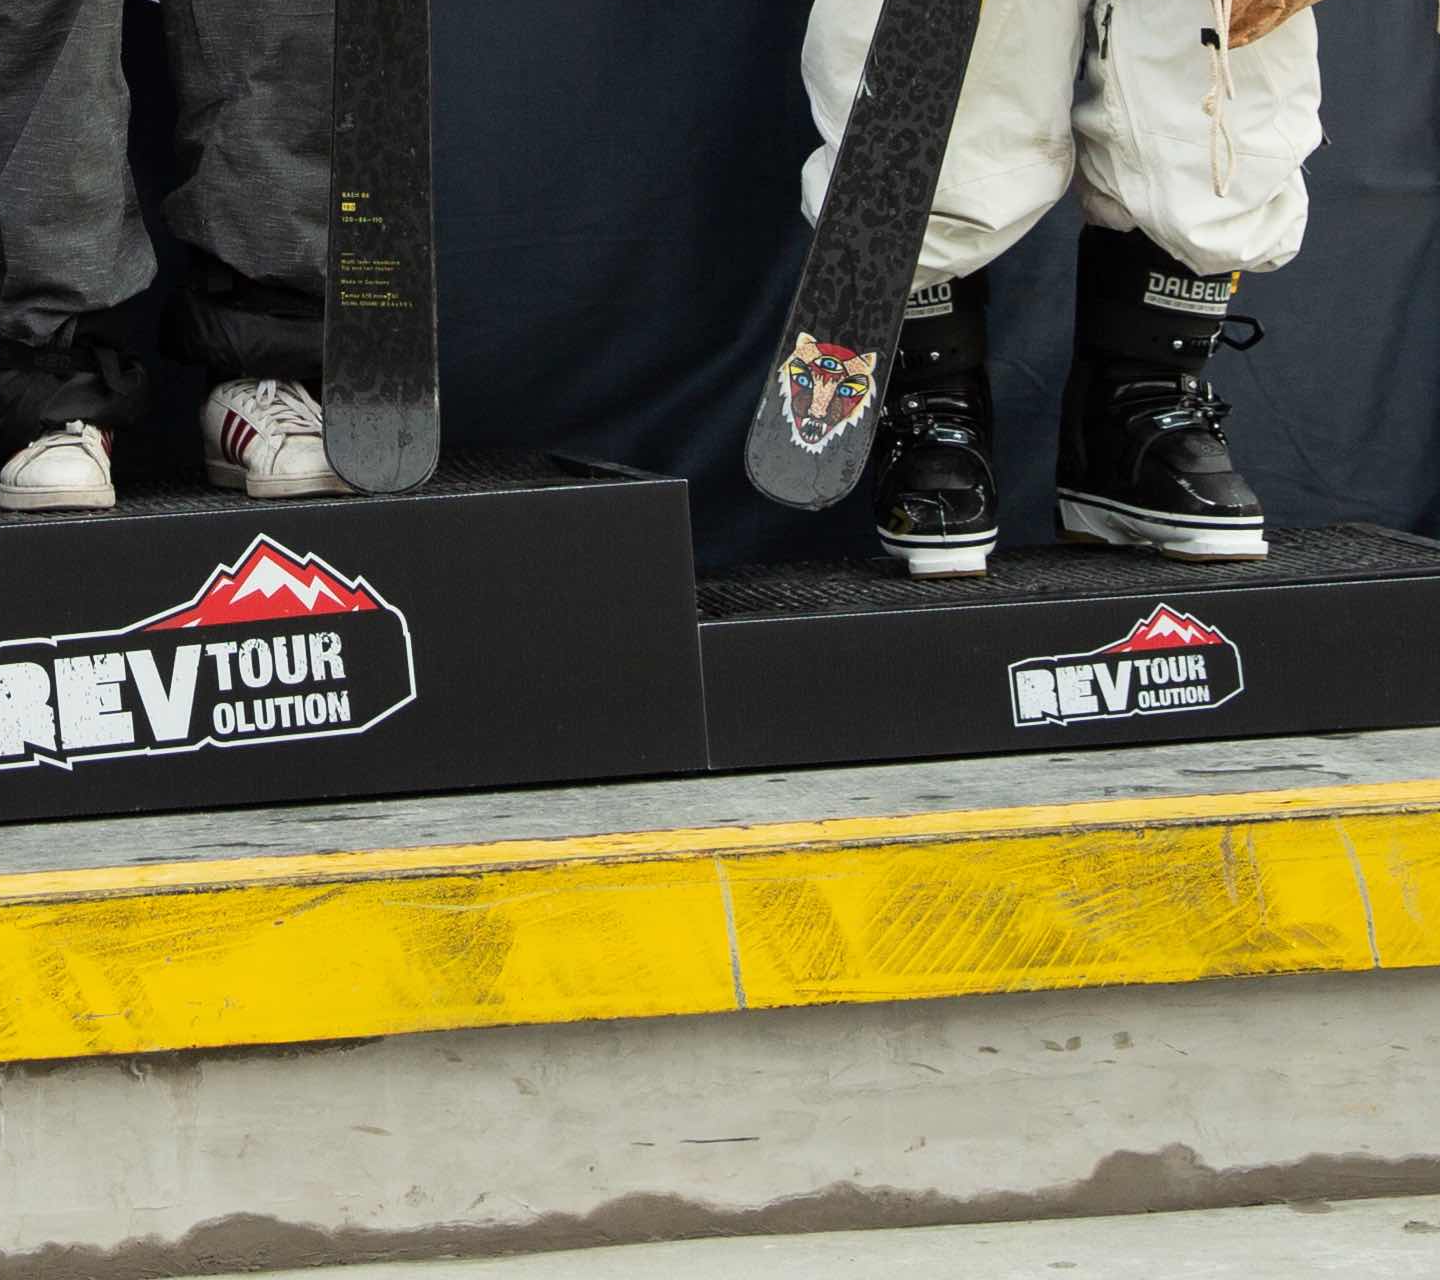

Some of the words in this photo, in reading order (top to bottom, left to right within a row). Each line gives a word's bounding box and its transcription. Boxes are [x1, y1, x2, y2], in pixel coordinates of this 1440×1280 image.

[205, 632, 346, 692] TOUR
[1016, 660, 1133, 720] REV
[1134, 654, 1208, 685] TOUR
[212, 691, 351, 735] OLUTION
[1138, 685, 1210, 709] OLUTION
